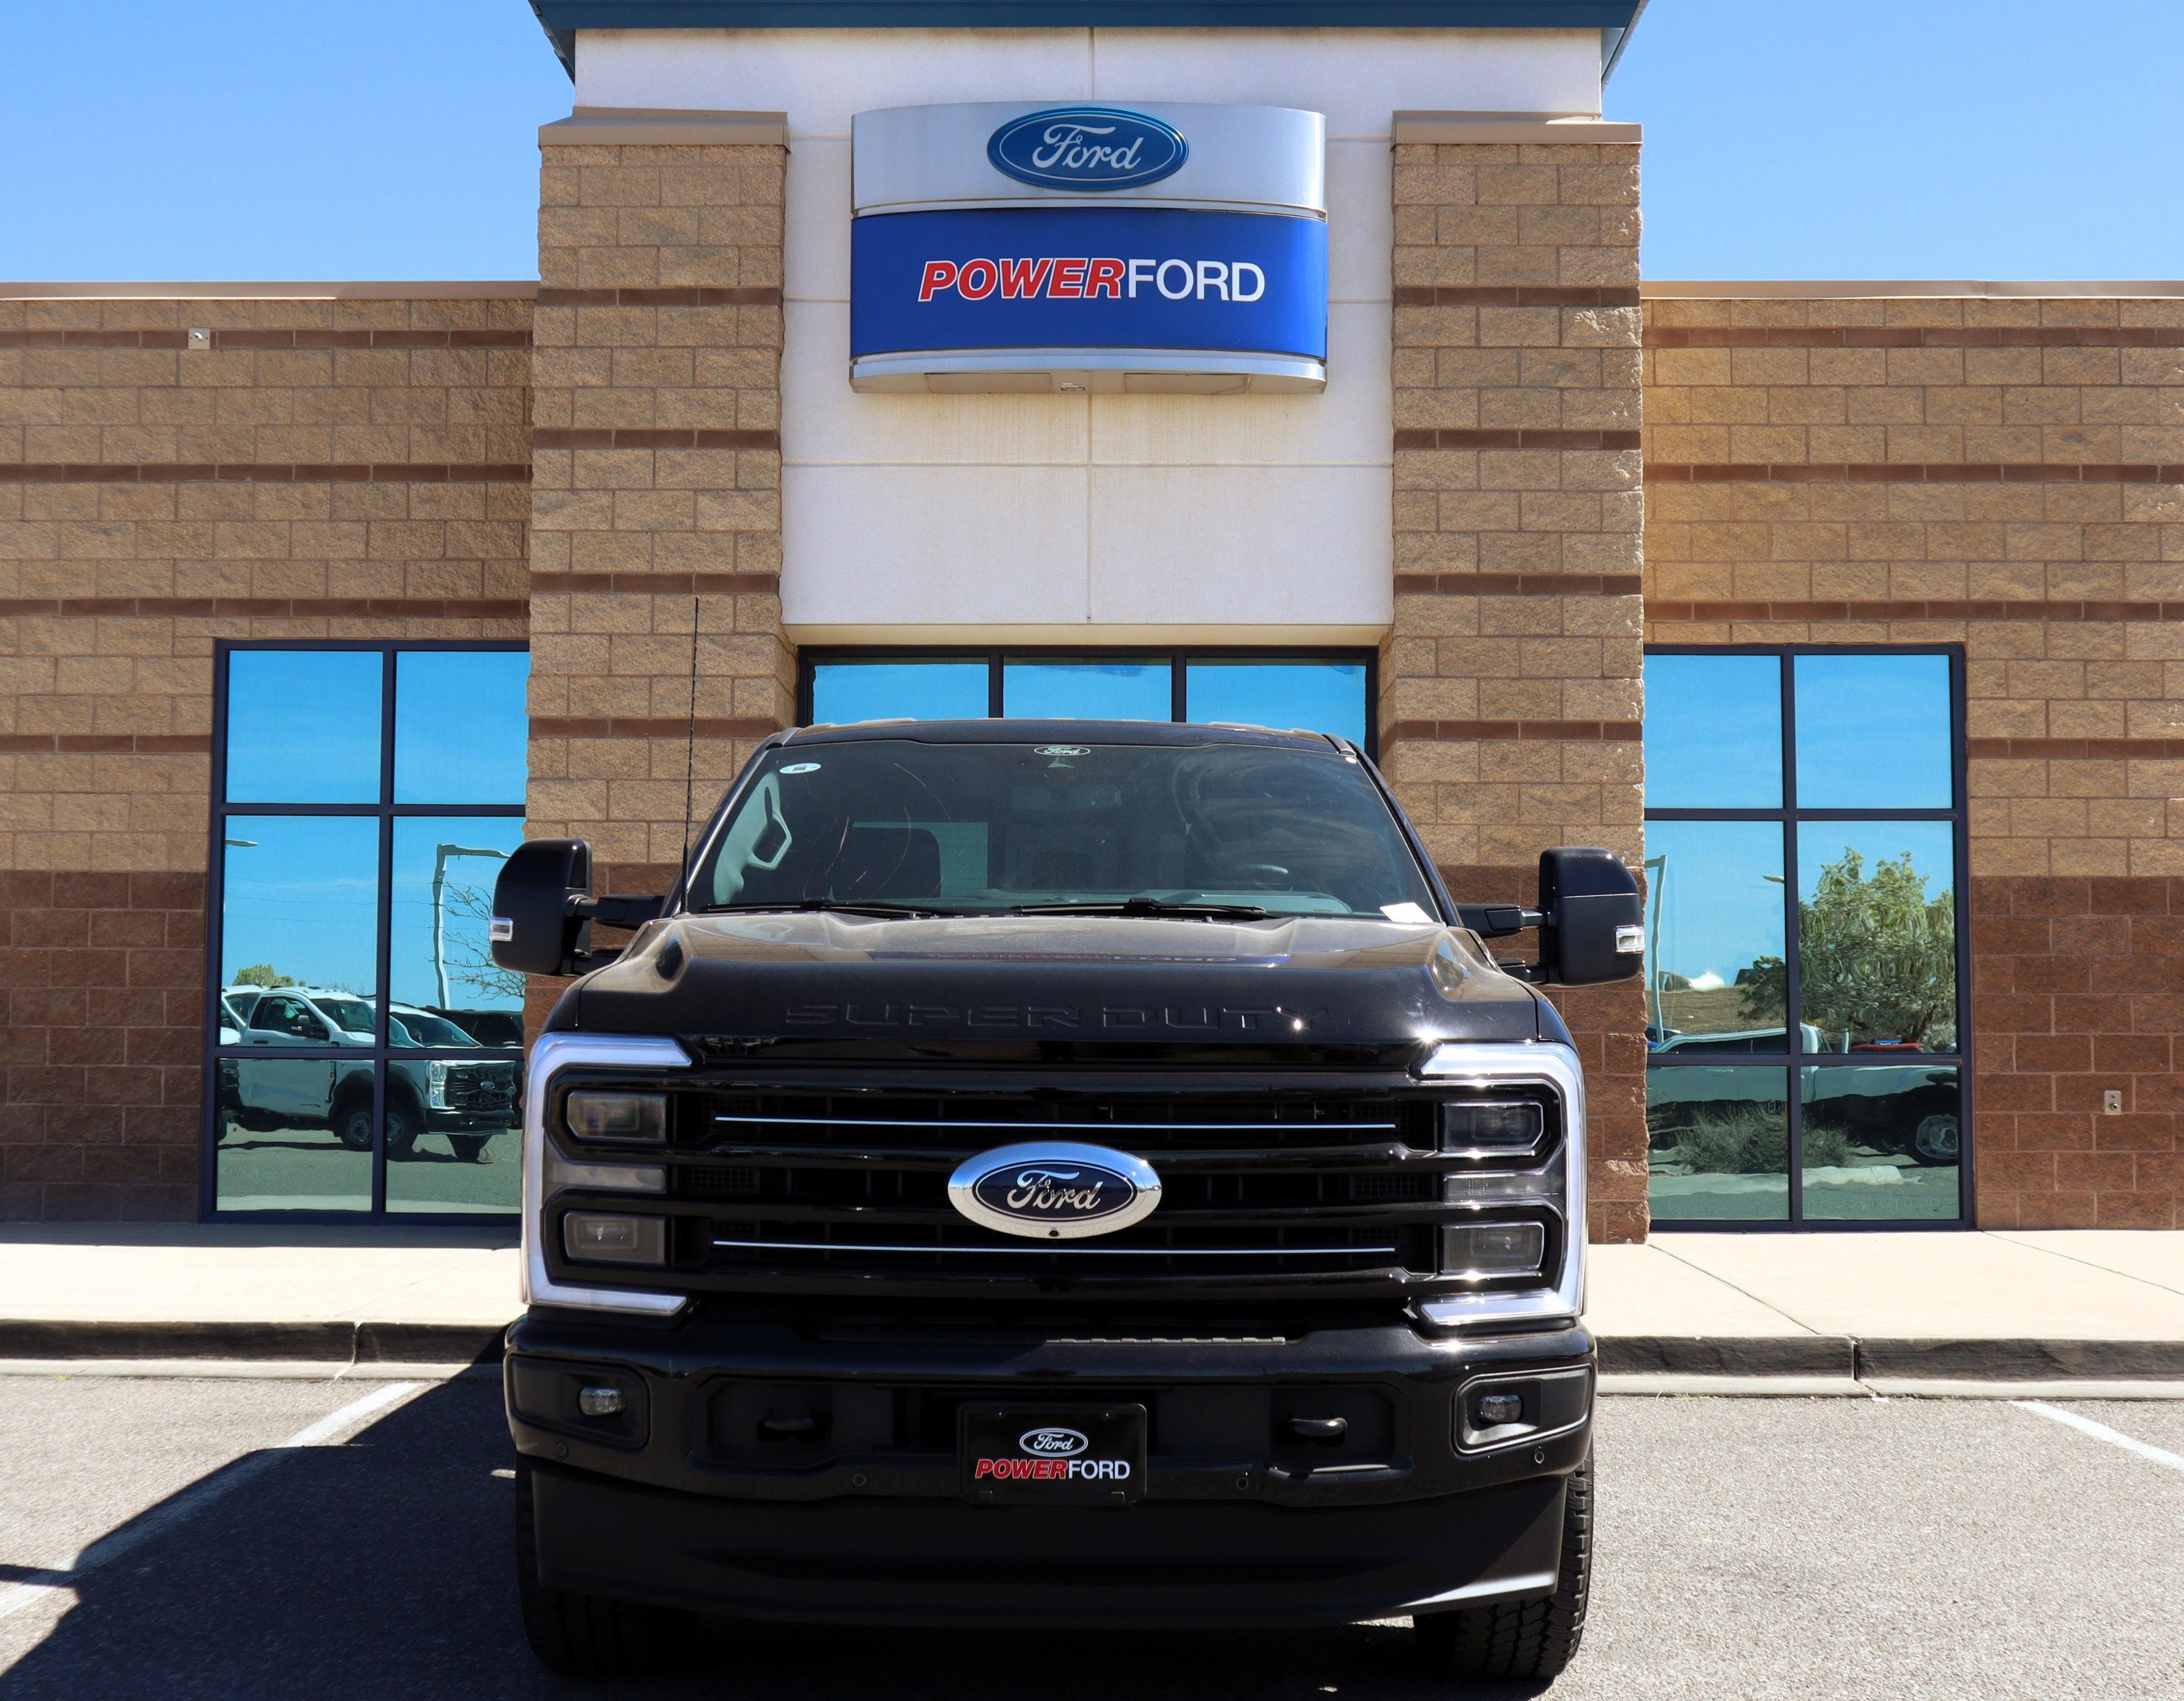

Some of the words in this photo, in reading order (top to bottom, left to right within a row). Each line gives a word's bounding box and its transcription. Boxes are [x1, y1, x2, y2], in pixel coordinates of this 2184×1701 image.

[1032, 124, 1144, 169] Ford
[786, 1004, 1080, 1027] SUPER
[1104, 1006, 1328, 1029] DUTY
[1006, 1170, 1103, 1210] Ford
[1034, 1433, 1073, 1450] Ford
